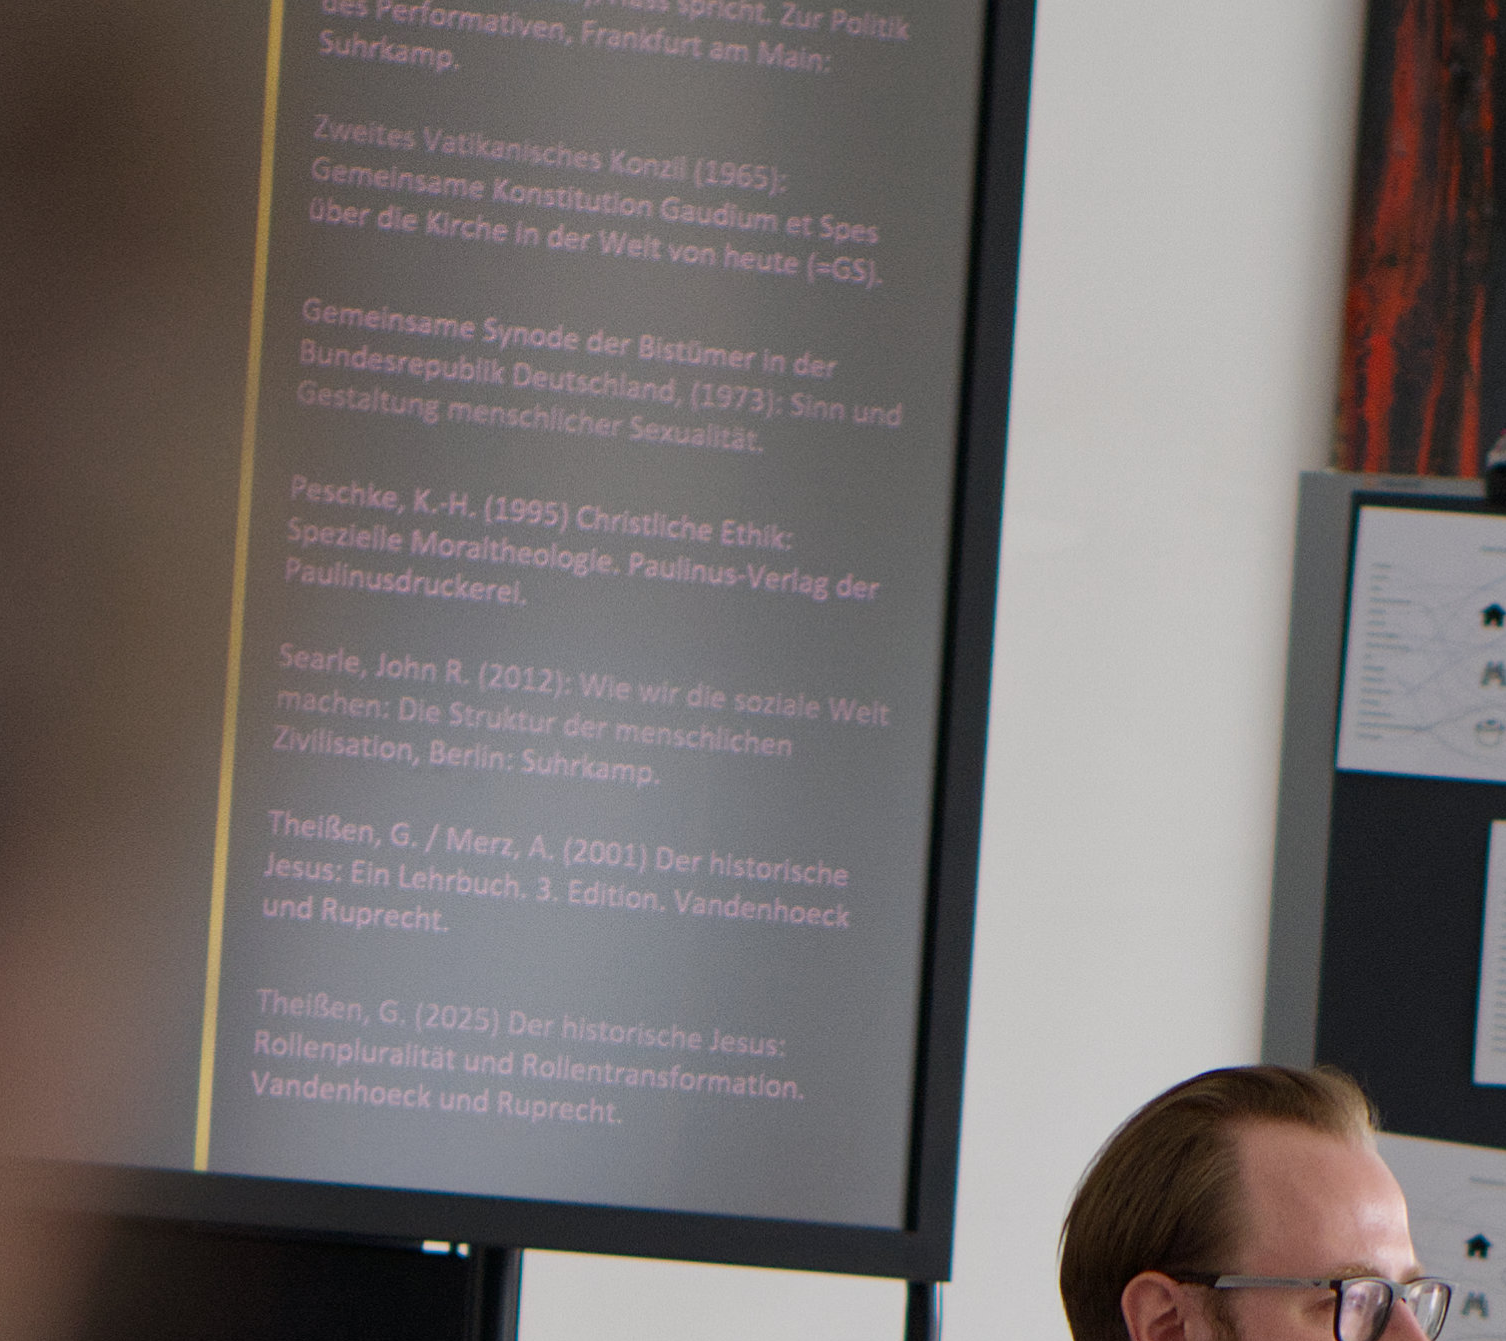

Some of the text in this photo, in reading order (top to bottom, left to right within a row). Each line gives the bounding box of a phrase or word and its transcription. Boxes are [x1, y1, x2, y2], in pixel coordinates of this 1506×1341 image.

[582, 19, 702, 57] Frankfurt
[709, 41, 750, 61] am
[780, 0, 824, 29] Zur
[830, 9, 909, 41] Politik
[313, 114, 415, 149] Zweites
[424, 127, 602, 172] Vatikanisches
[610, 150, 686, 179] Konzil
[311, 156, 879, 244] Gemeinsame Konstitution Gaudium et Spes
[309, 198, 371, 226] über
[377, 205, 418, 232] die
[426, 211, 509, 242] Kirche
[515, 222, 540, 245] in
[547, 224, 592, 250] der
[598, 230, 661, 261] Welt
[668, 245, 717, 266] von
[724, 243, 800, 276] heute
[301, 297, 837, 378] Gemeinsame Synode der Bistümer in der
[297, 381, 439, 424] Gestaltung
[448, 401, 622, 437] menschlicher
[300, 339, 505, 384] Bundesrepublik
[790, 392, 846, 420] Sinn
[852, 403, 904, 428] und
[484, 495, 569, 533] (1995)
[576, 504, 713, 542] Christliche
[288, 517, 403, 552] Spezielle
[628, 552, 830, 602] Paulinus-Verlag
[835, 573, 880, 600] der
[376, 652, 436, 678] John
[580, 673, 632, 700] Wie
[639, 685, 679, 703] wir
[686, 683, 726, 709] die
[734, 693, 821, 719] soziale
[829, 698, 890, 726] Welt
[399, 697, 441, 724] Die
[450, 701, 555, 733] Struktur
[564, 713, 608, 738] der
[615, 723, 793, 756] menschlichen
[563, 838, 648, 874] (2001)
[655, 845, 702, 872] Der
[710, 850, 849, 888] historische
[262, 895, 313, 920] und
[351, 859, 390, 886] Ein
[674, 890, 850, 928] Vandenhoeck
[253, 1029, 456, 1070] Rollenpluralität
[464, 1051, 514, 1075] und
[416, 1003, 499, 1038] (2025)
[509, 1010, 553, 1036] Der
[561, 1014, 702, 1051] historische
[249, 1070, 431, 1108] Vandenhoeck
[439, 1089, 489, 1113] und
